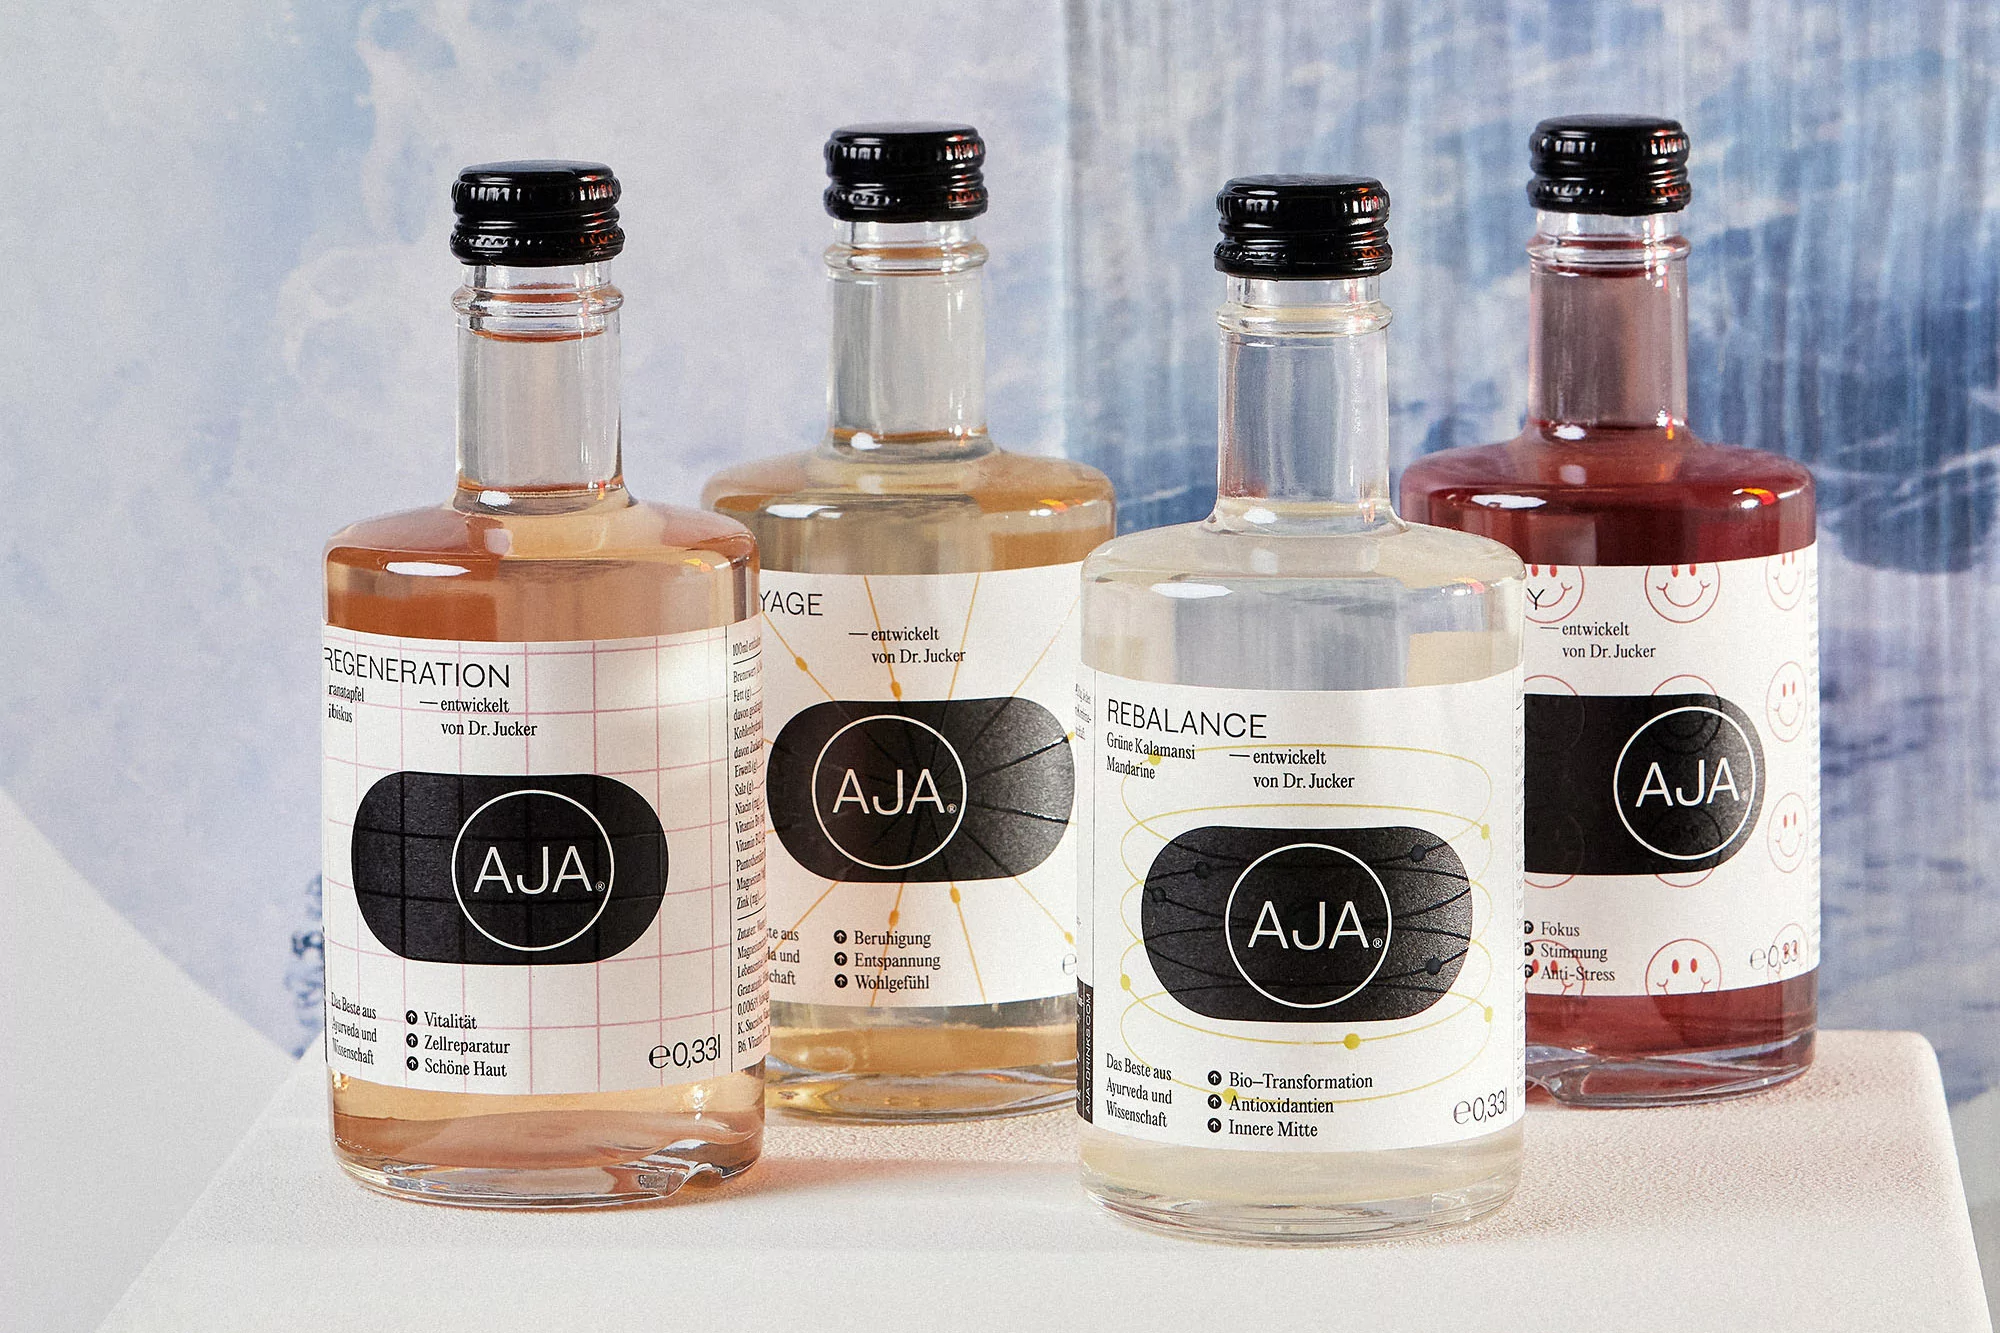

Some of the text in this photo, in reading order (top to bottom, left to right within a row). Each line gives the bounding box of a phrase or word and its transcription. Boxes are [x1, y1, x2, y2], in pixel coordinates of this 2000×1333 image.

[871, 626, 940, 641] entwickelt
[1562, 622, 1630, 636] entwickelt
[871, 649, 966, 664] von Dr. Jucker
[1562, 644, 1656, 658] von Dr. Jucker
[324, 647, 510, 688] REGENERATION
[440, 697, 510, 713] entwickelt
[1108, 699, 1267, 738] REBALANCE
[441, 721, 538, 737] von Dr. Jucker
[1107, 732, 1196, 760] Grüne Kalamansi
[1253, 750, 1327, 765] entwickelt
[1107, 756, 1156, 779] Mandarine
[1253, 773, 1355, 789] von Dr. Jucker
[1635, 757, 1740, 807] AJA
[780, 929, 800, 941] aus
[1541, 921, 1580, 937] Fokus
[854, 930, 931, 948] Beruhigung
[779, 949, 800, 963] und
[1541, 943, 1608, 961] Stimmung
[855, 953, 941, 970] Entspannung
[1541, 964, 1615, 982] Anti-Stress
[855, 975, 930, 993] Wohlgefühl
[342, 997, 360, 1016] Beste
[361, 1006, 377, 1020] aus
[424, 1011, 478, 1030] Vitalität
[361, 1028, 377, 1042] und
[424, 1035, 510, 1055] Zellreparatur
[425, 1058, 508, 1078] Schöne Haut
[1106, 1053, 1172, 1081] Das Beste aus
[1106, 1077, 1172, 1105] Ayurveda und
[1229, 1095, 1334, 1113] Antioxidantien
[1106, 1099, 1168, 1128] Wissenschaft
[1229, 1119, 1318, 1138] Innere Mitte
